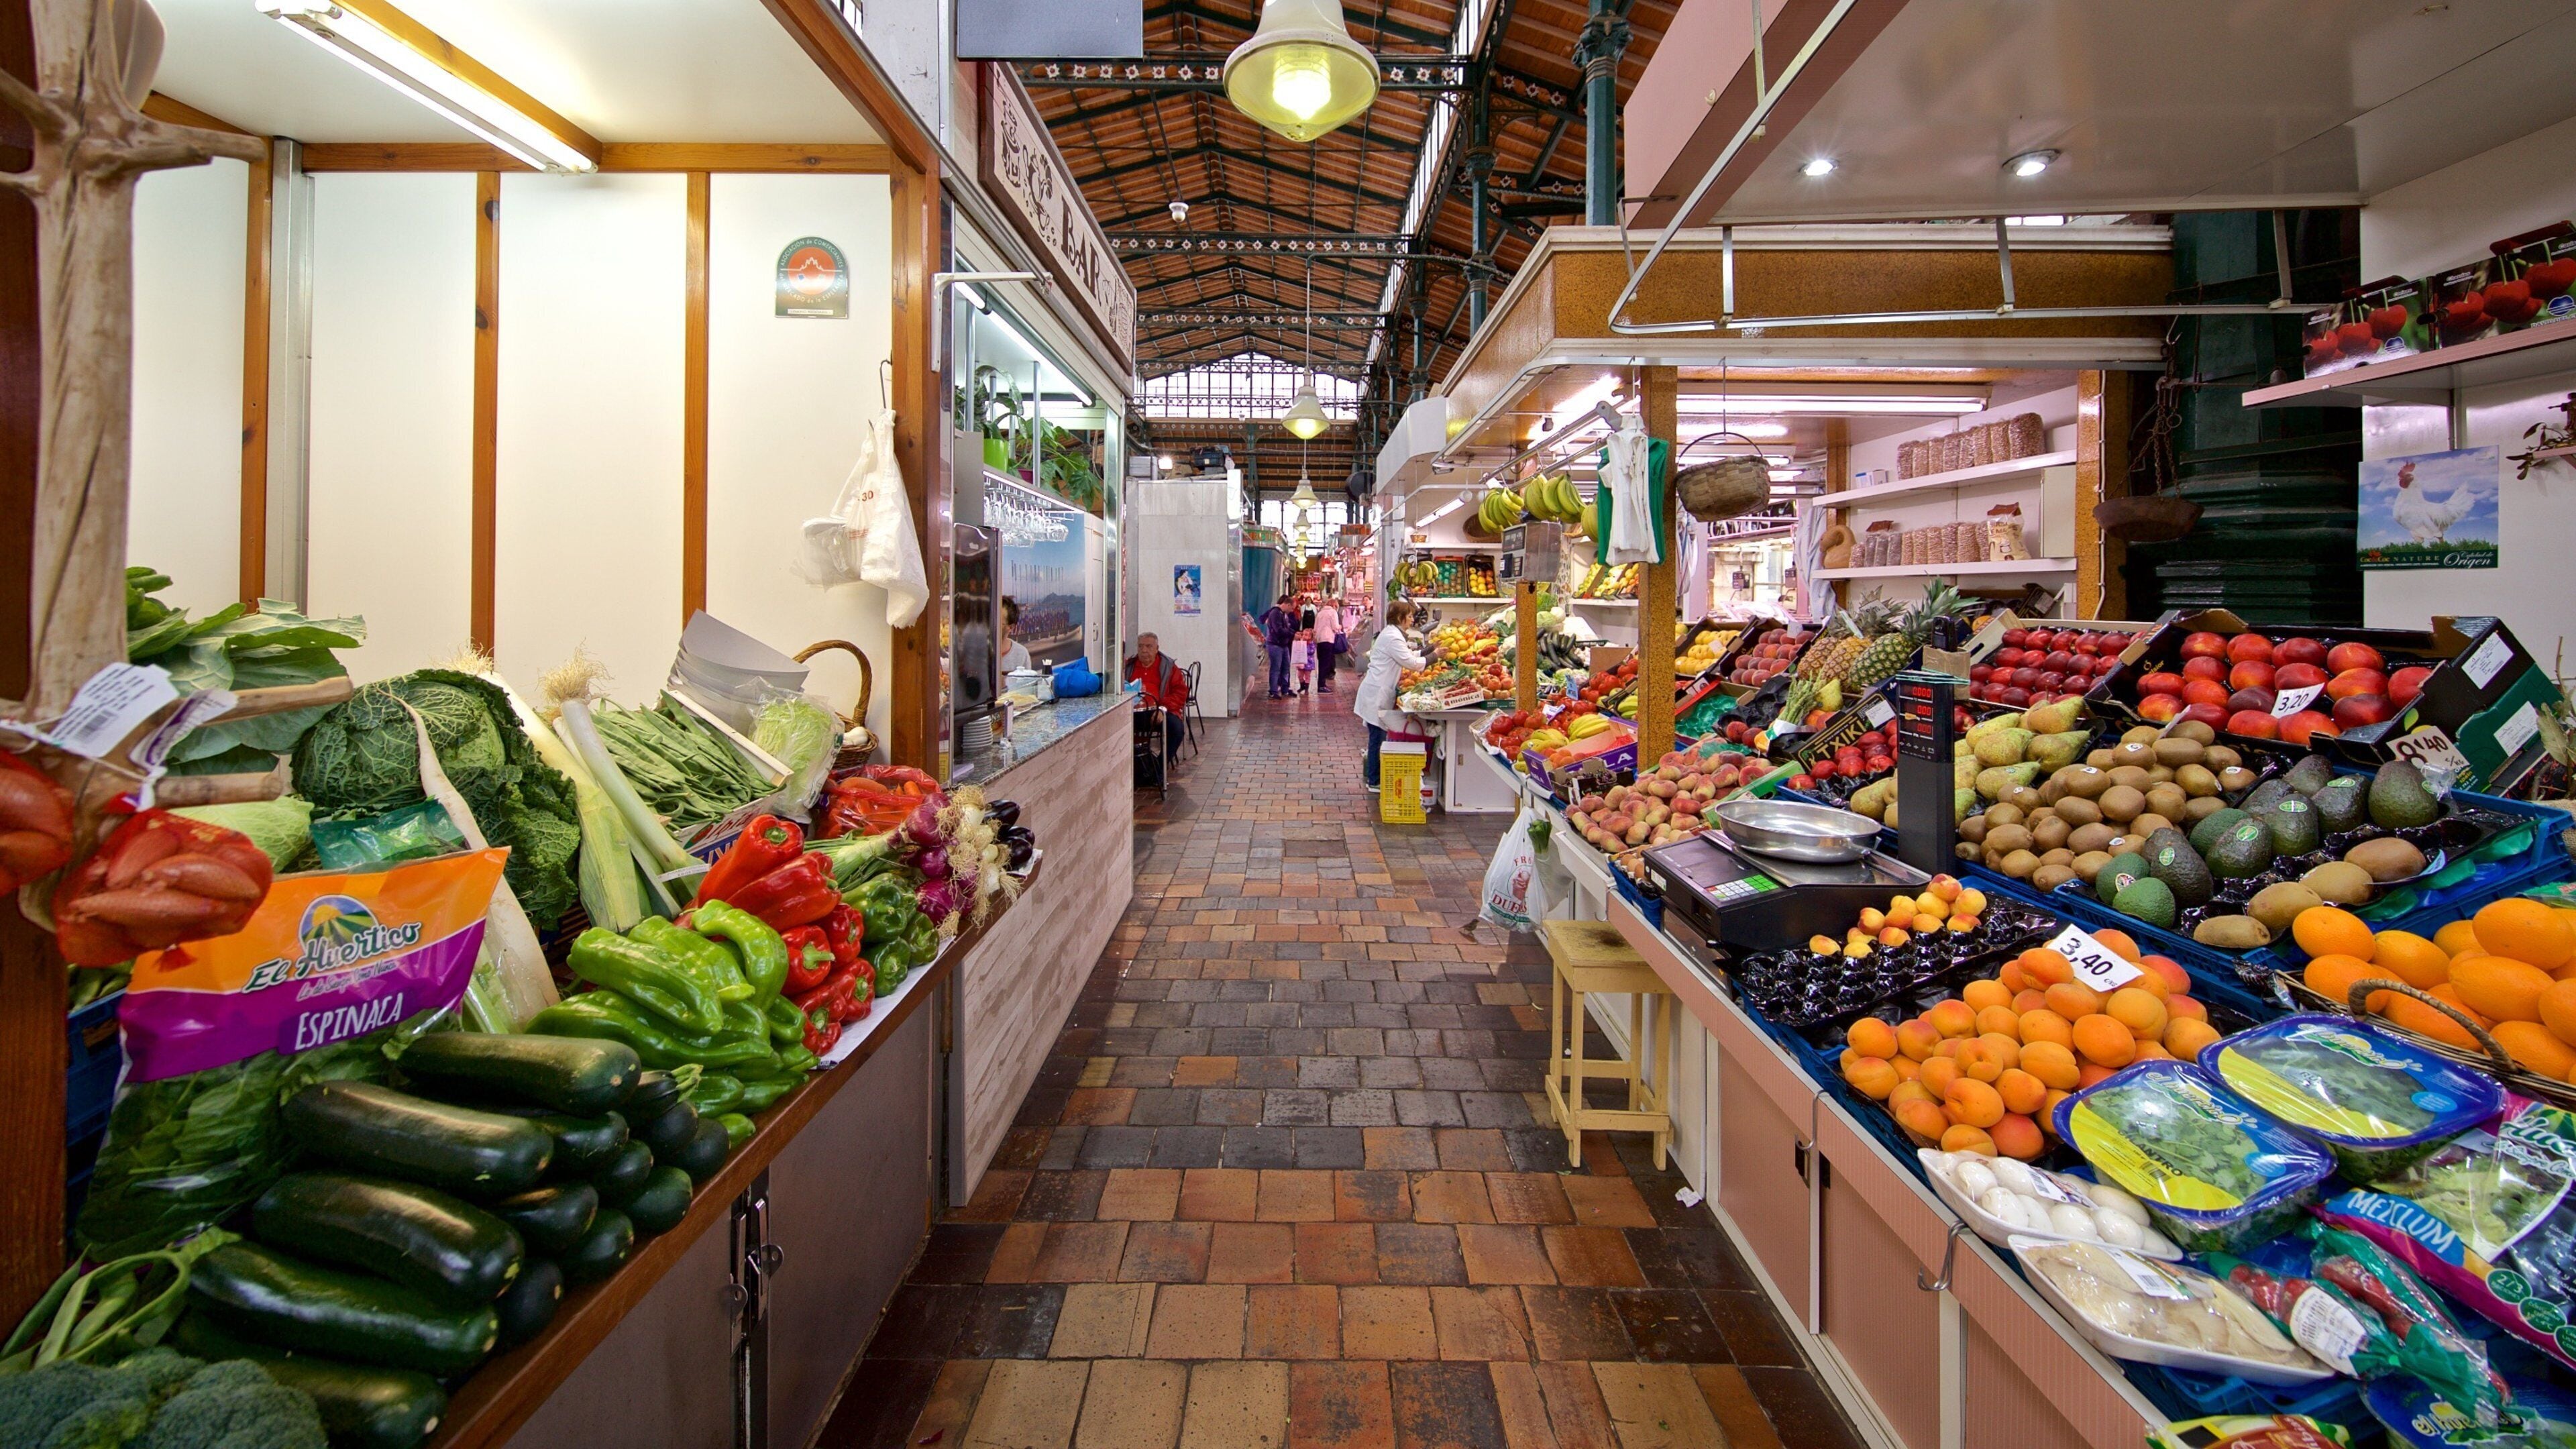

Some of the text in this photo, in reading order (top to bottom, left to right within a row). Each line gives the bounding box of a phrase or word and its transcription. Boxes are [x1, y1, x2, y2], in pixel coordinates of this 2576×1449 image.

[1061, 194, 1102, 307] BAR
[2443, 552, 2491, 569] Origen
[2278, 693, 2309, 712] 3,20
[1816, 719, 1867, 759] TXIKI
[244, 923, 421, 992] El Huertico
[2059, 937, 2113, 975] 3,40
[294, 993, 404, 1051] ESPINACA
[2348, 1190, 2457, 1254] MEZCLUM
[2497, 1273, 2523, 1293] 2/3
